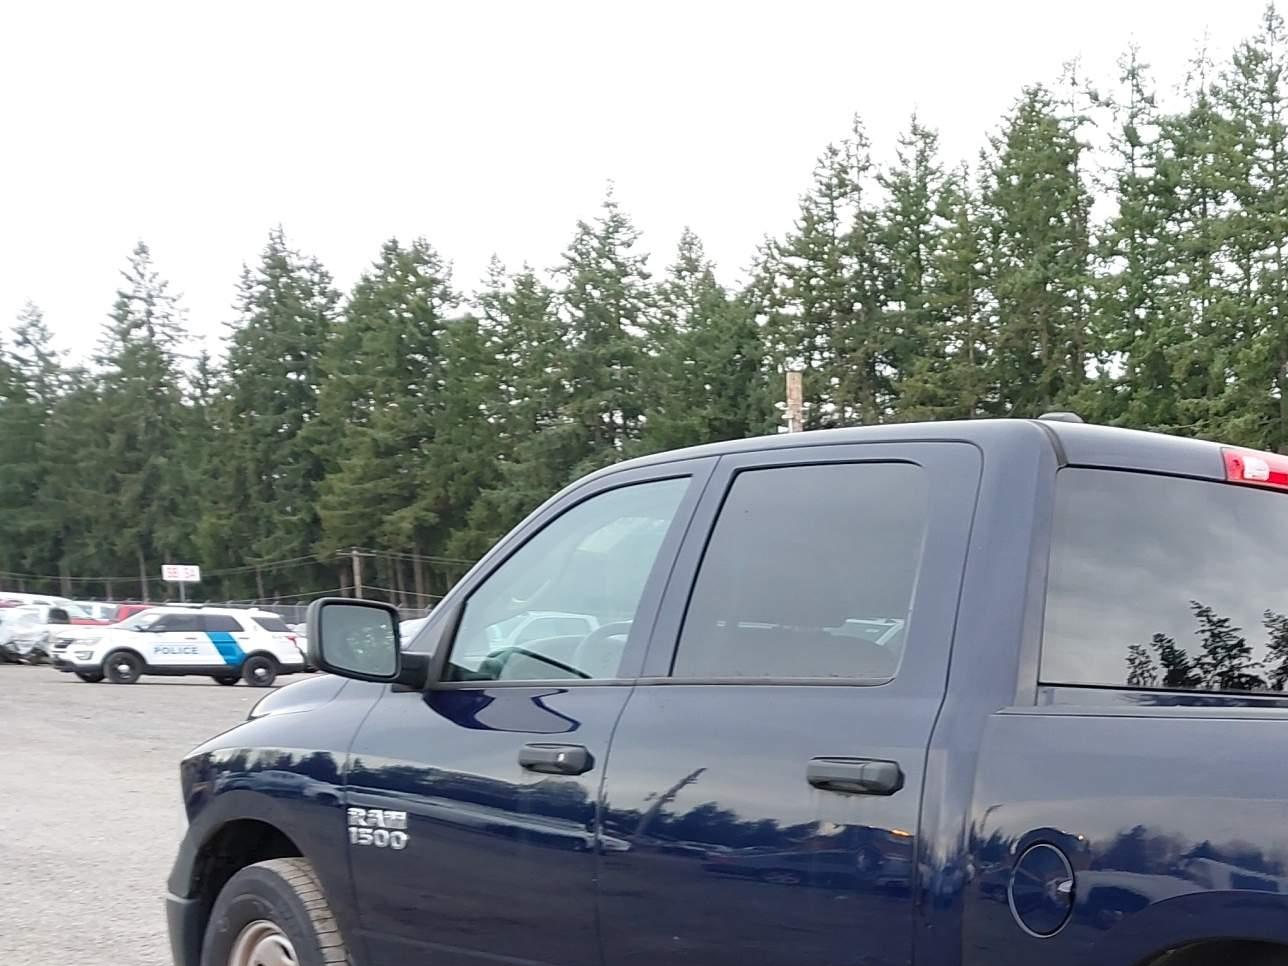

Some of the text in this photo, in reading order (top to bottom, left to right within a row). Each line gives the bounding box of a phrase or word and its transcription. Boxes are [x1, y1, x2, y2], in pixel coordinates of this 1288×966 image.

[153, 646, 199, 655] POLICE
[347, 807, 408, 830] RAM
[348, 827, 409, 850] 1500
